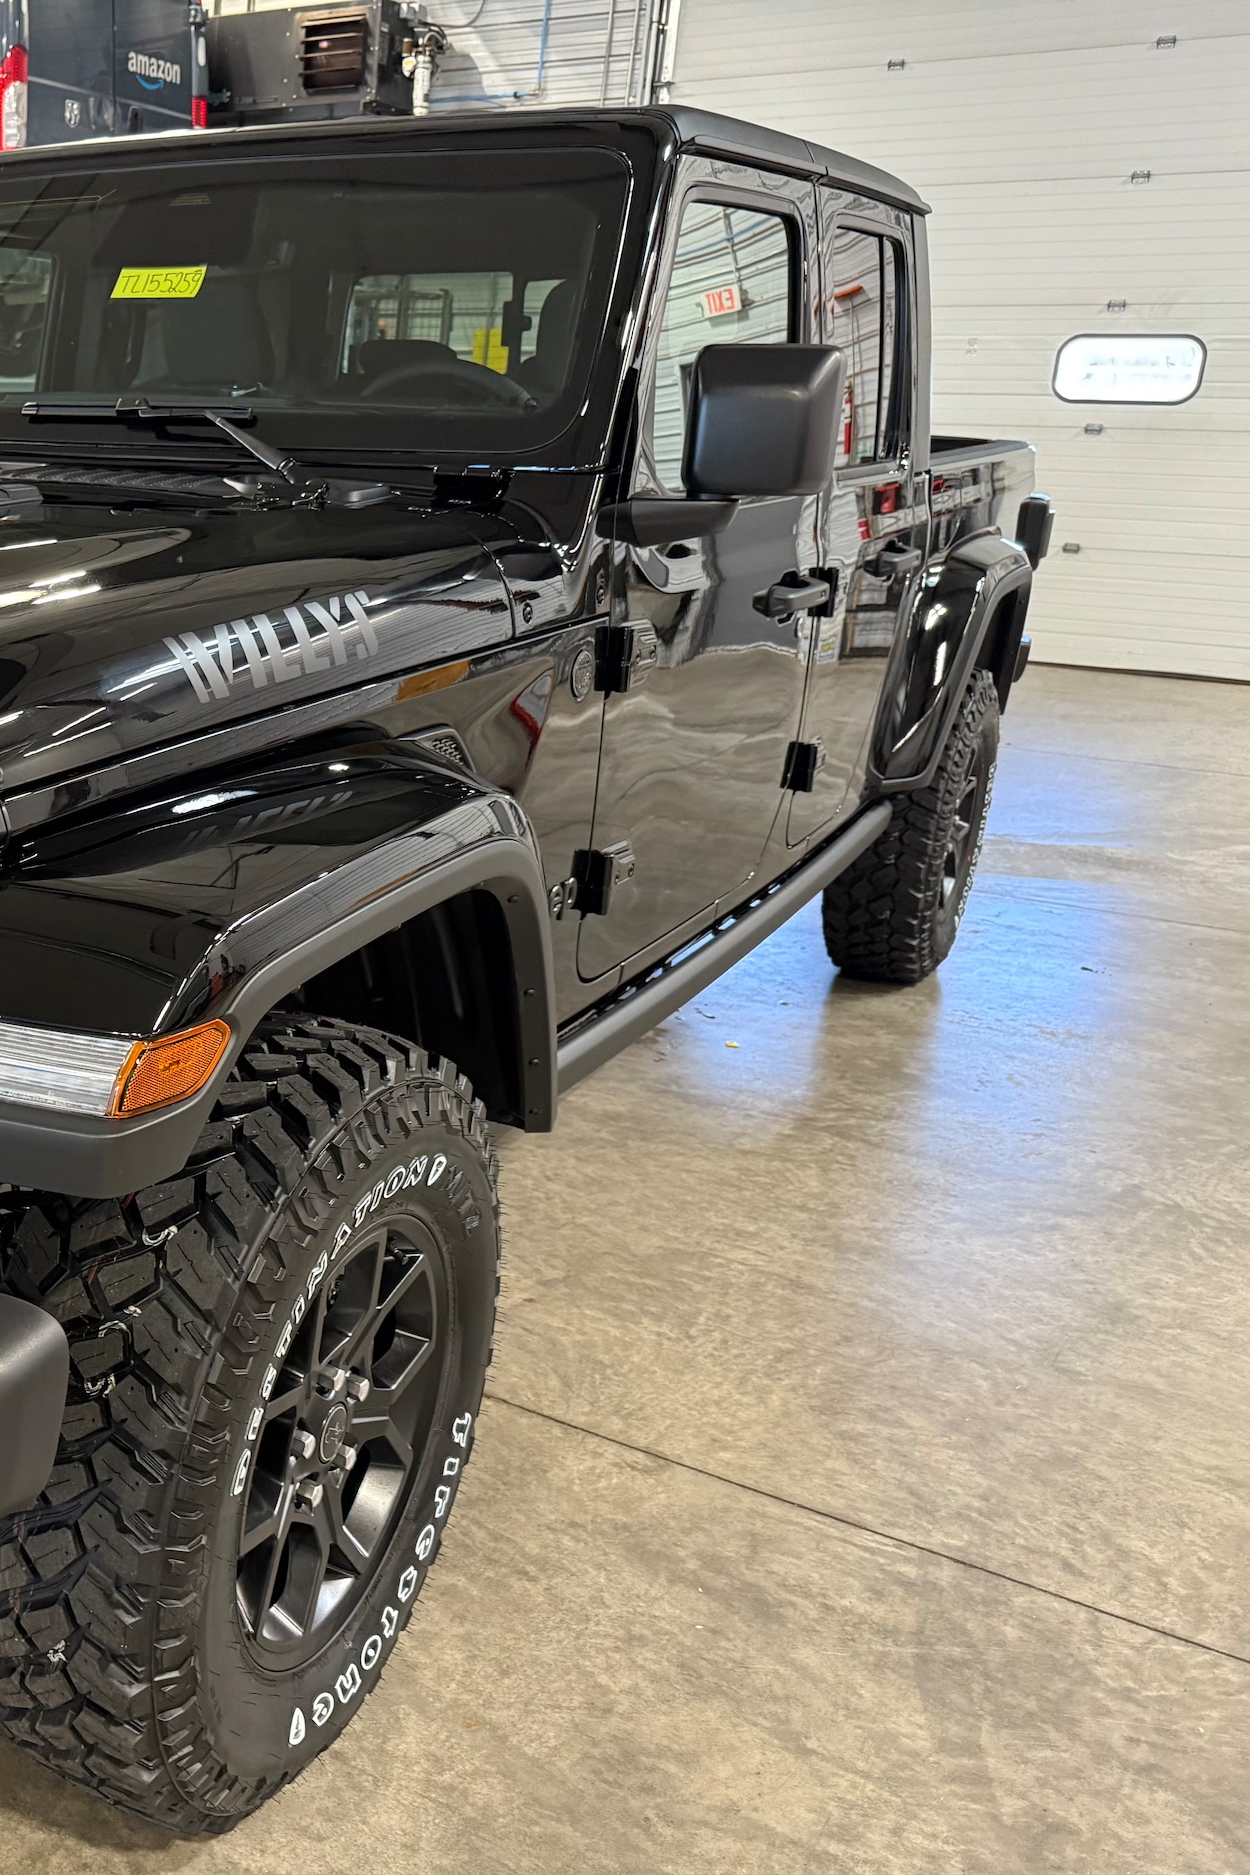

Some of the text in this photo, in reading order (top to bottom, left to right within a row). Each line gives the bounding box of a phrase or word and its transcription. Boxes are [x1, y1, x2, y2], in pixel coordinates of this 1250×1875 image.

[128, 51, 181, 85] amazon
[162, 591, 379, 703] WILLYS
[230, 1155, 429, 1497] DESTINATION
